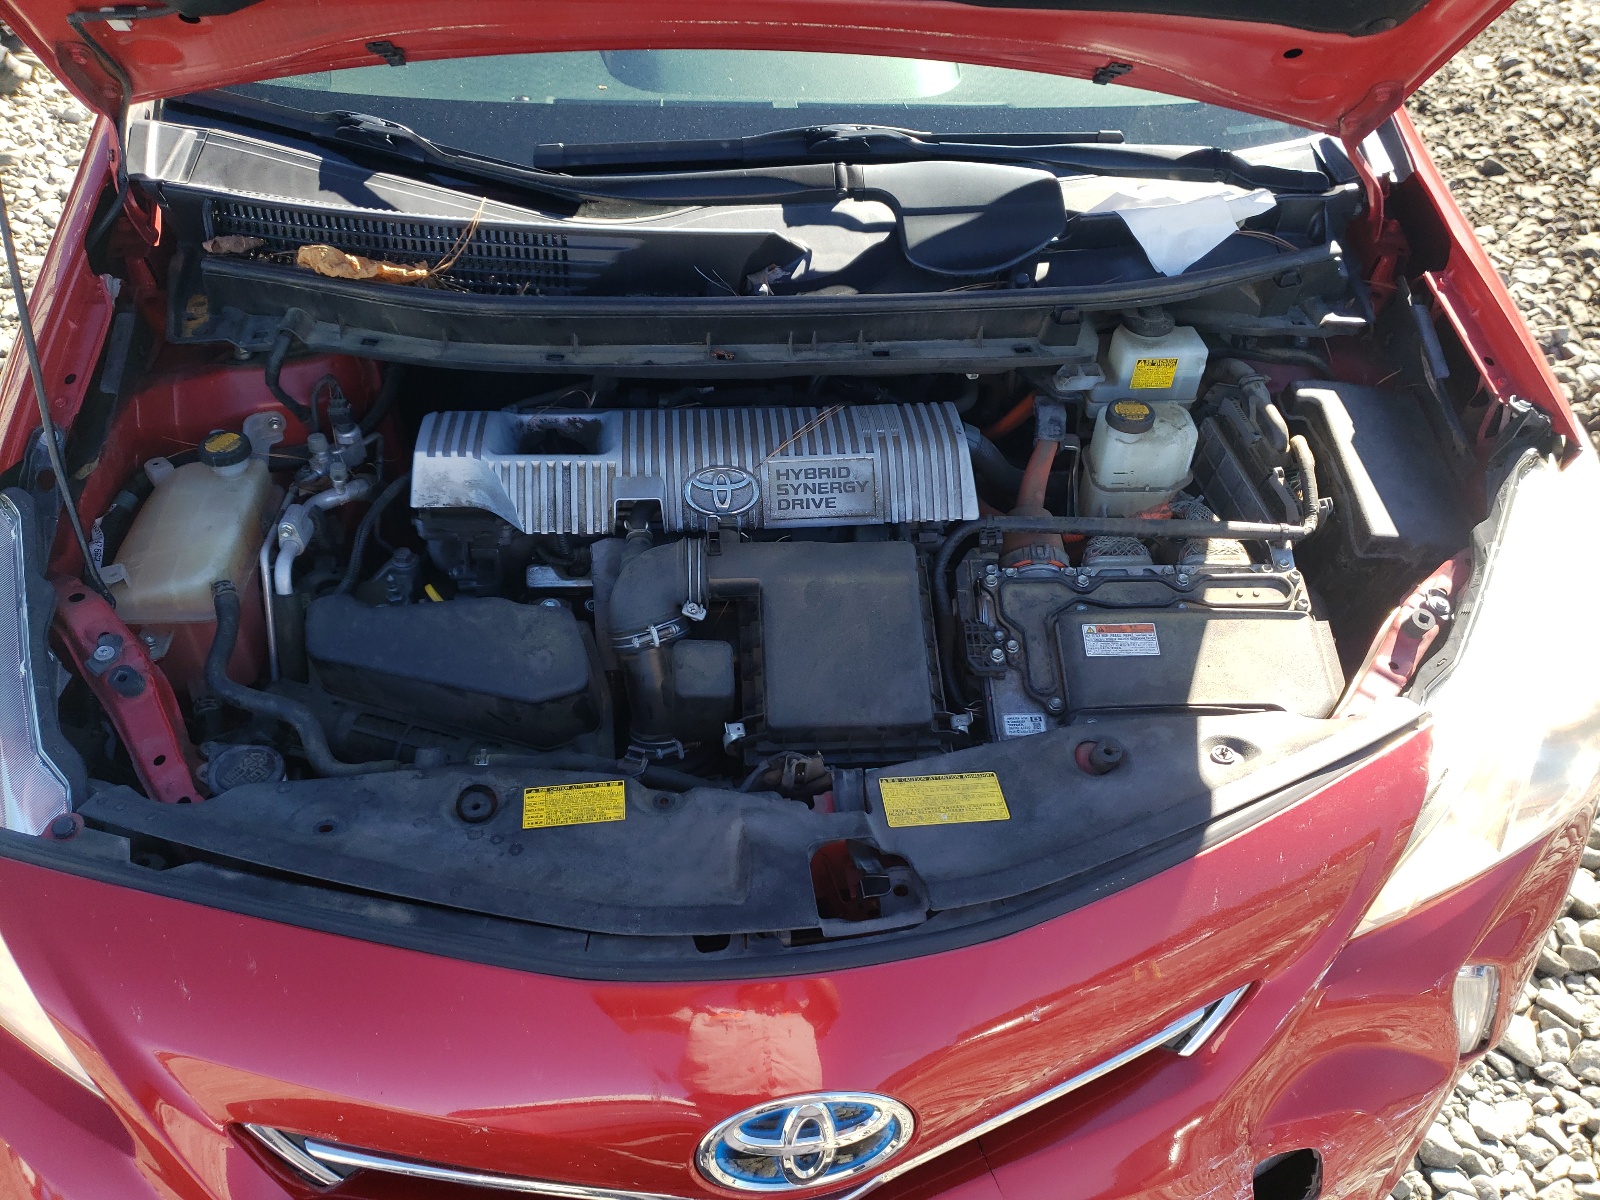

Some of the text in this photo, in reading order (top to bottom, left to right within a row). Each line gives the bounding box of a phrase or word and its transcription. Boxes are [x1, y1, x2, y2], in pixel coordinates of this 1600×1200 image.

[776, 467, 851, 480] HYBRID
[776, 481, 869, 496] SYNERGY
[777, 497, 837, 511] DRIVE
